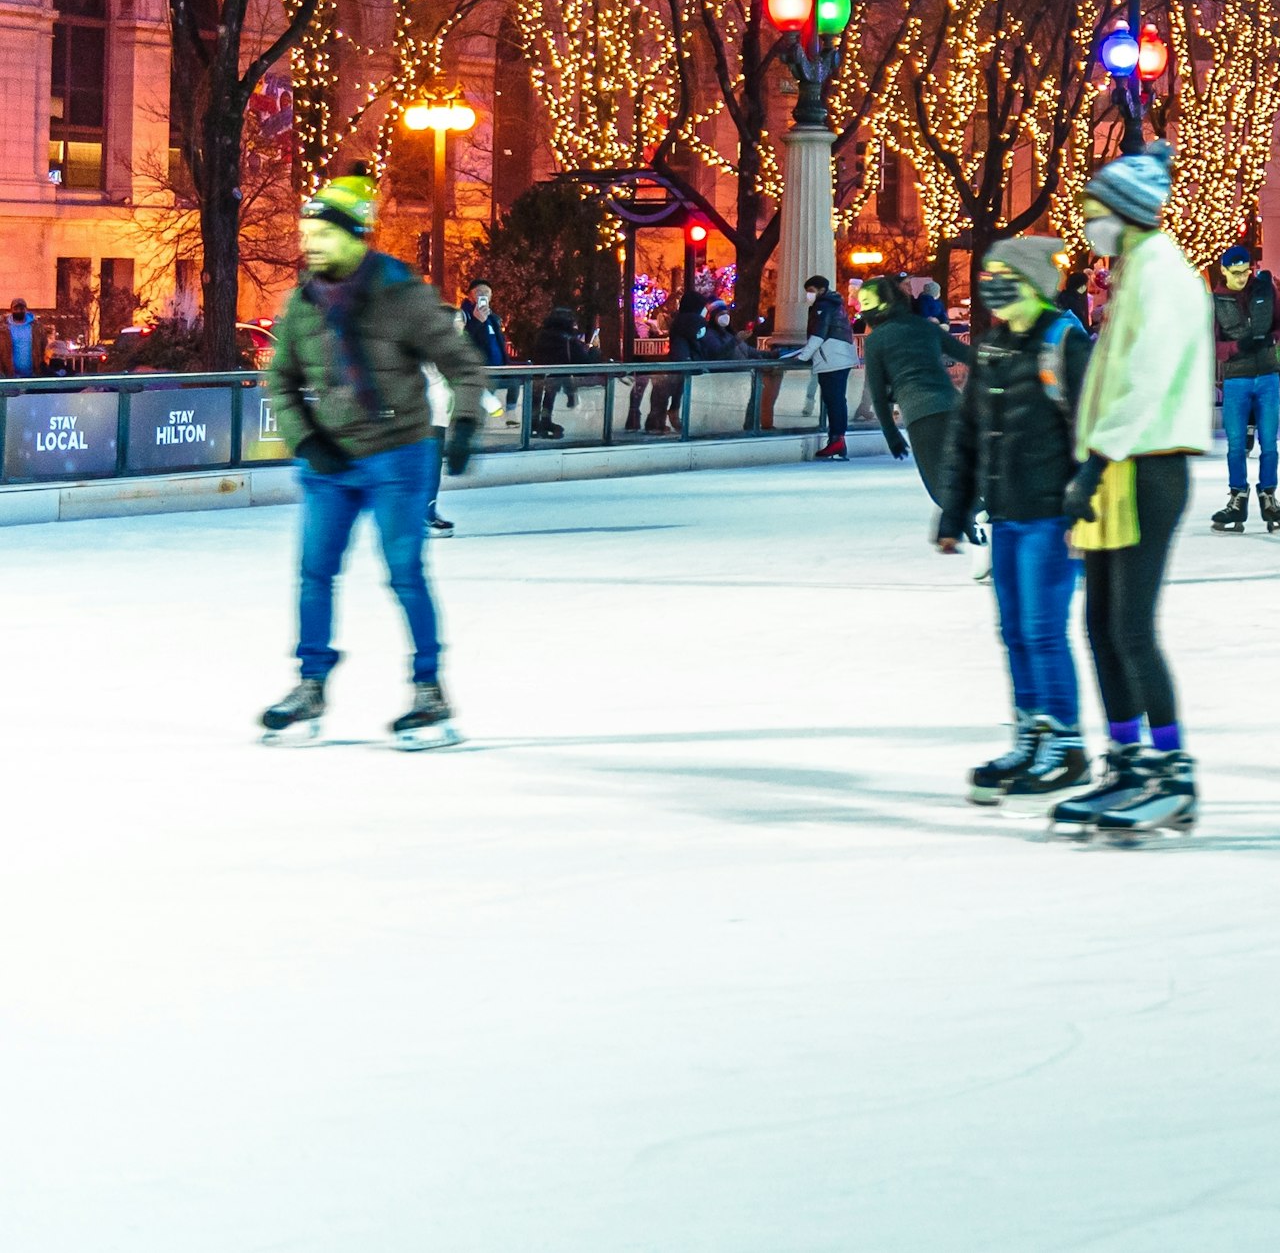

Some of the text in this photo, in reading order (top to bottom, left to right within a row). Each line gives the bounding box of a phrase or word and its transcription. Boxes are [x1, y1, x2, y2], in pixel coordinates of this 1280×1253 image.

[49, 416, 77, 430] STAY
[169, 410, 195, 425] STAY
[36, 431, 88, 451] LOCAL
[156, 424, 206, 445] HILTON
